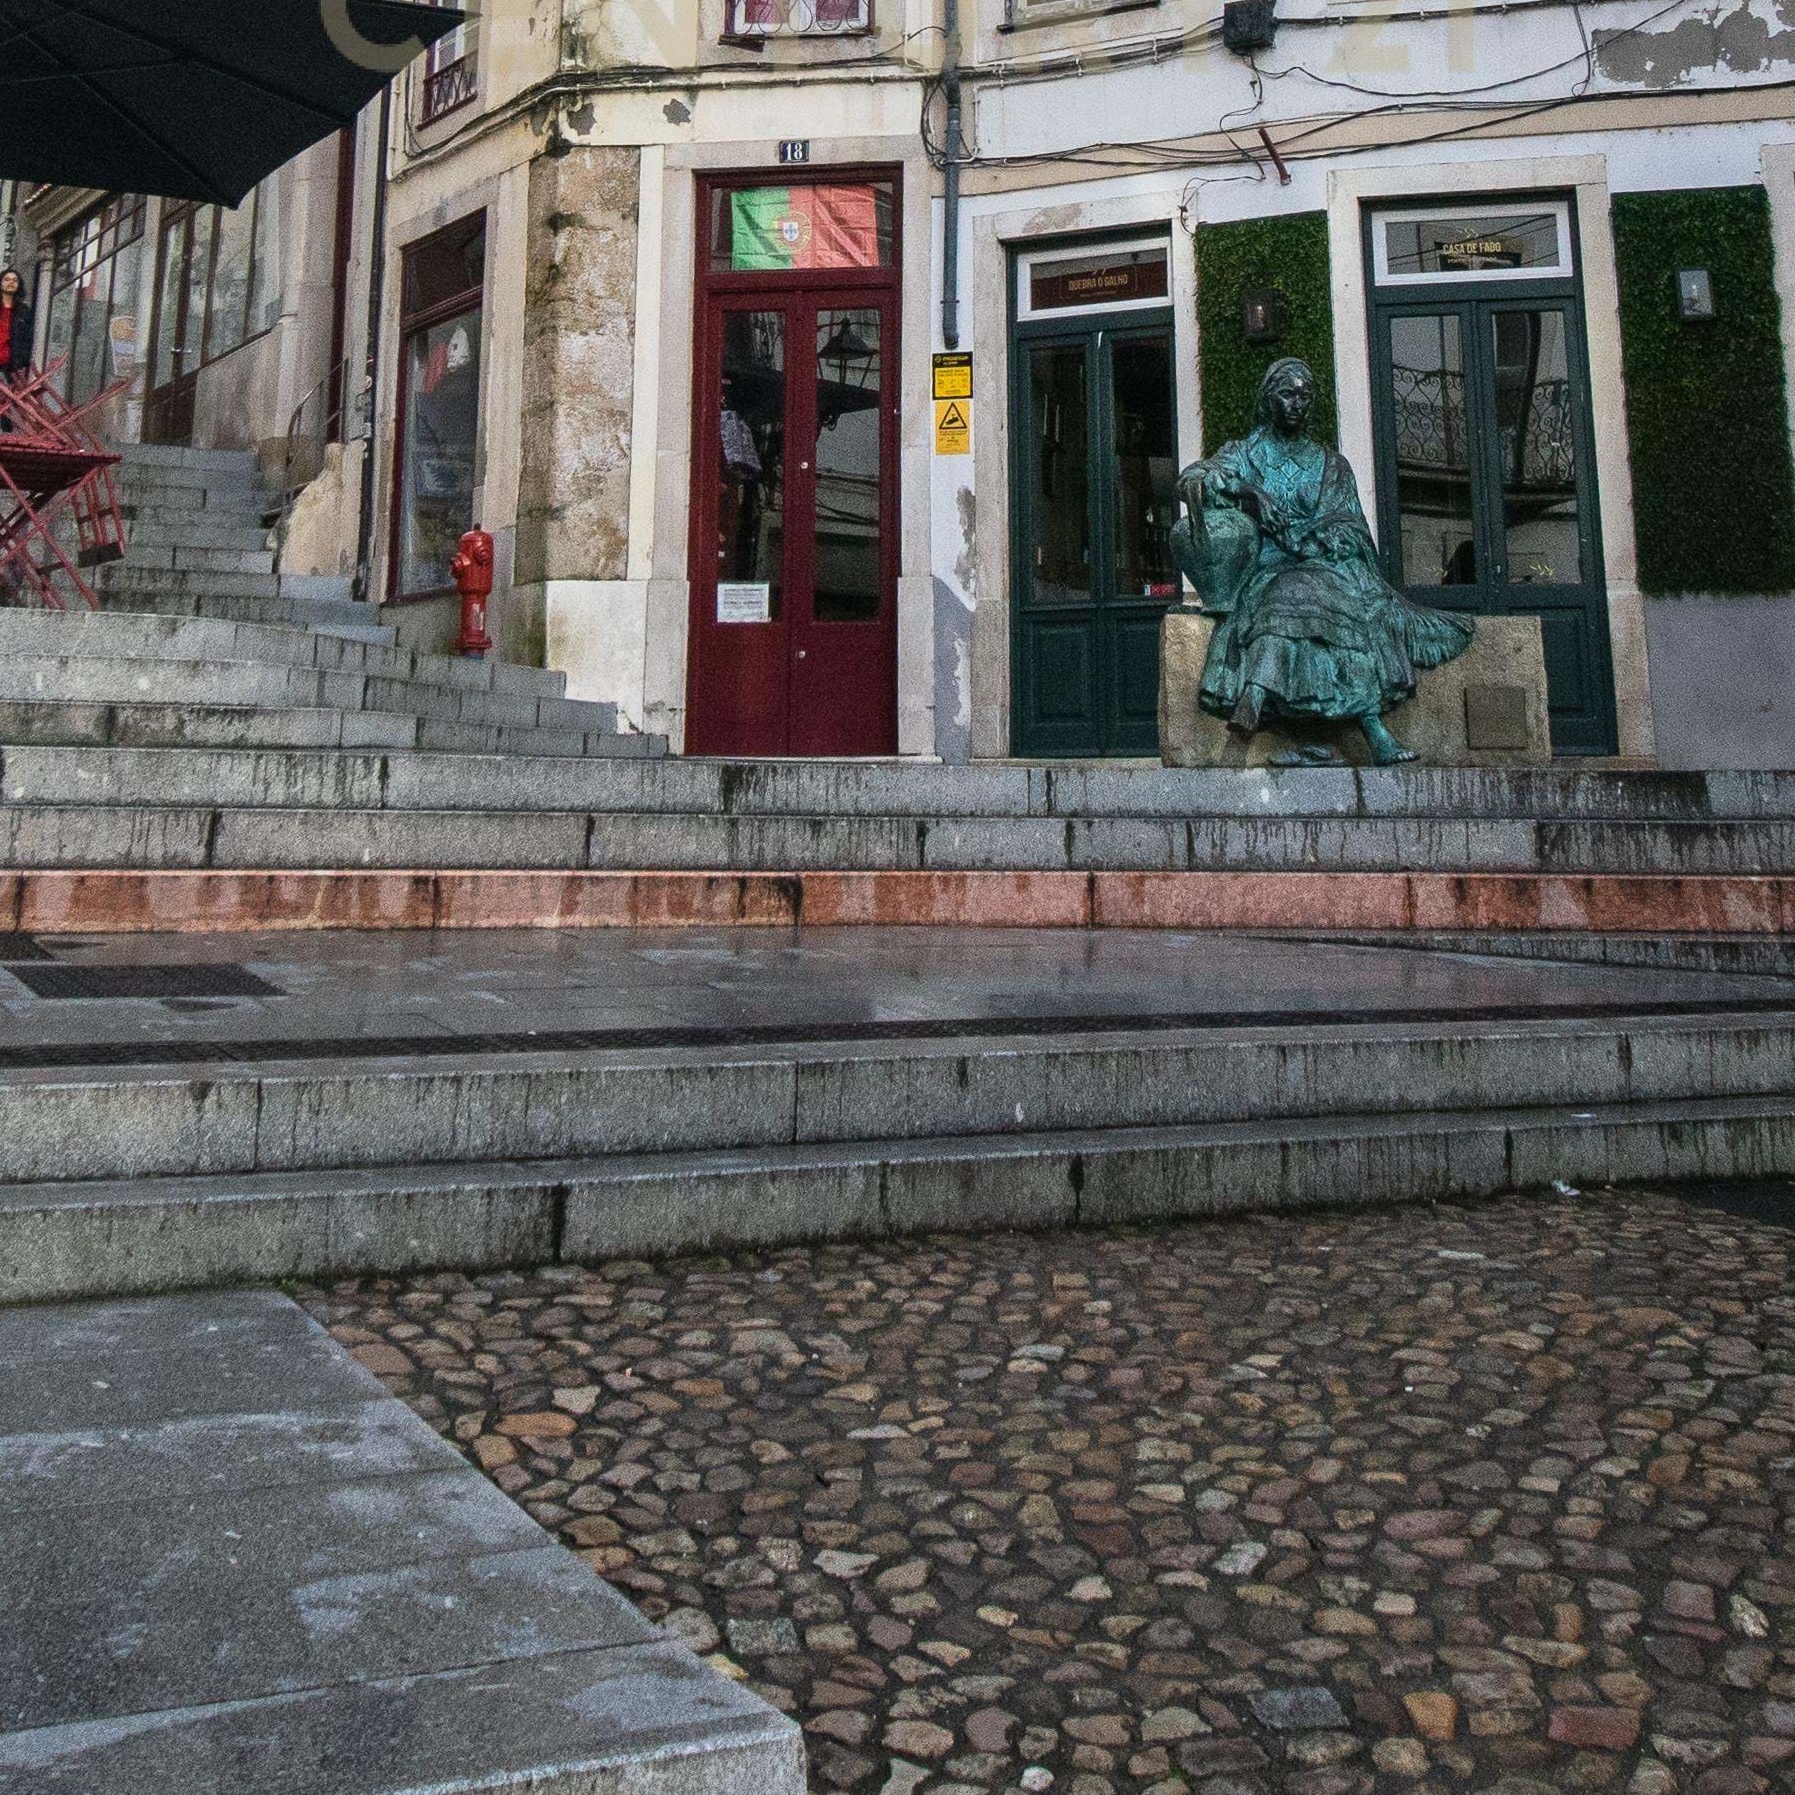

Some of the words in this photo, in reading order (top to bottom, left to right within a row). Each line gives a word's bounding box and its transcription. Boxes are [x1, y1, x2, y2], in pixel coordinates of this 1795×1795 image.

[786, 143, 804, 160] 18
[1442, 243, 1464, 255] CASA
[1466, 242, 1478, 253] DE
[1479, 241, 1502, 253] FADO
